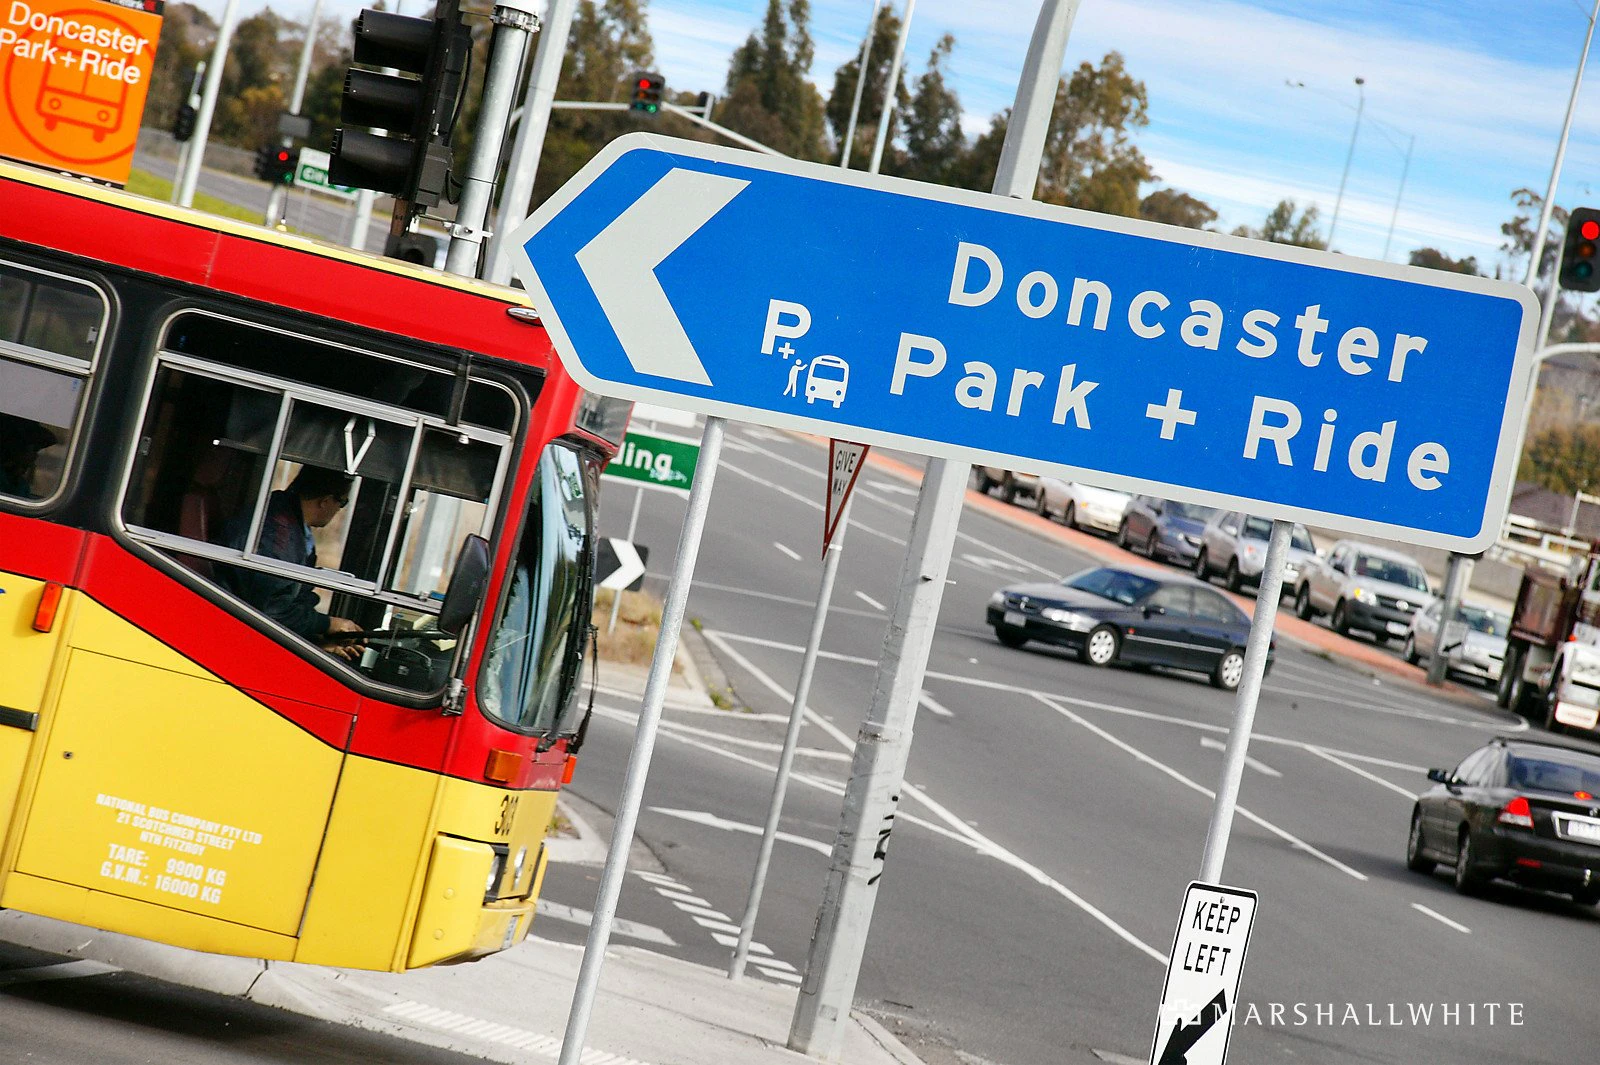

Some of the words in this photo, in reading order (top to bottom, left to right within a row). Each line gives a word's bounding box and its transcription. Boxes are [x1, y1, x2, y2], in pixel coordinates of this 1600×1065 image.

[8, 1, 149, 56] Doncaster
[0, 28, 58, 65] Park
[60, 51, 77, 68] +
[79, 48, 141, 85] Ride
[948, 242, 1428, 383] Doncaster
[890, 333, 1100, 430] Park
[1145, 389, 1198, 441] +
[1243, 396, 1451, 491] Ride
[835, 449, 857, 474] GIVE
[833, 478, 848, 497] WAY
[96, 793, 146, 816] NATIONAL
[148, 806, 170, 821] BUS
[171, 812, 221, 833] COMPANY
[221, 824, 243, 839] PTY
[242, 831, 263, 845] LTD
[116, 812, 131, 825] 21
[196, 831, 235, 850] STREET
[108, 843, 150, 867] TARE:
[166, 858, 204, 880] 9900
[205, 868, 227, 887] KG
[162, 836, 206, 856] FITZROY
[155, 874, 199, 898] 16000
[200, 886, 222, 905] KG
[1191, 900, 1241, 935] KEEP
[1183, 942, 1231, 976] LEFT
